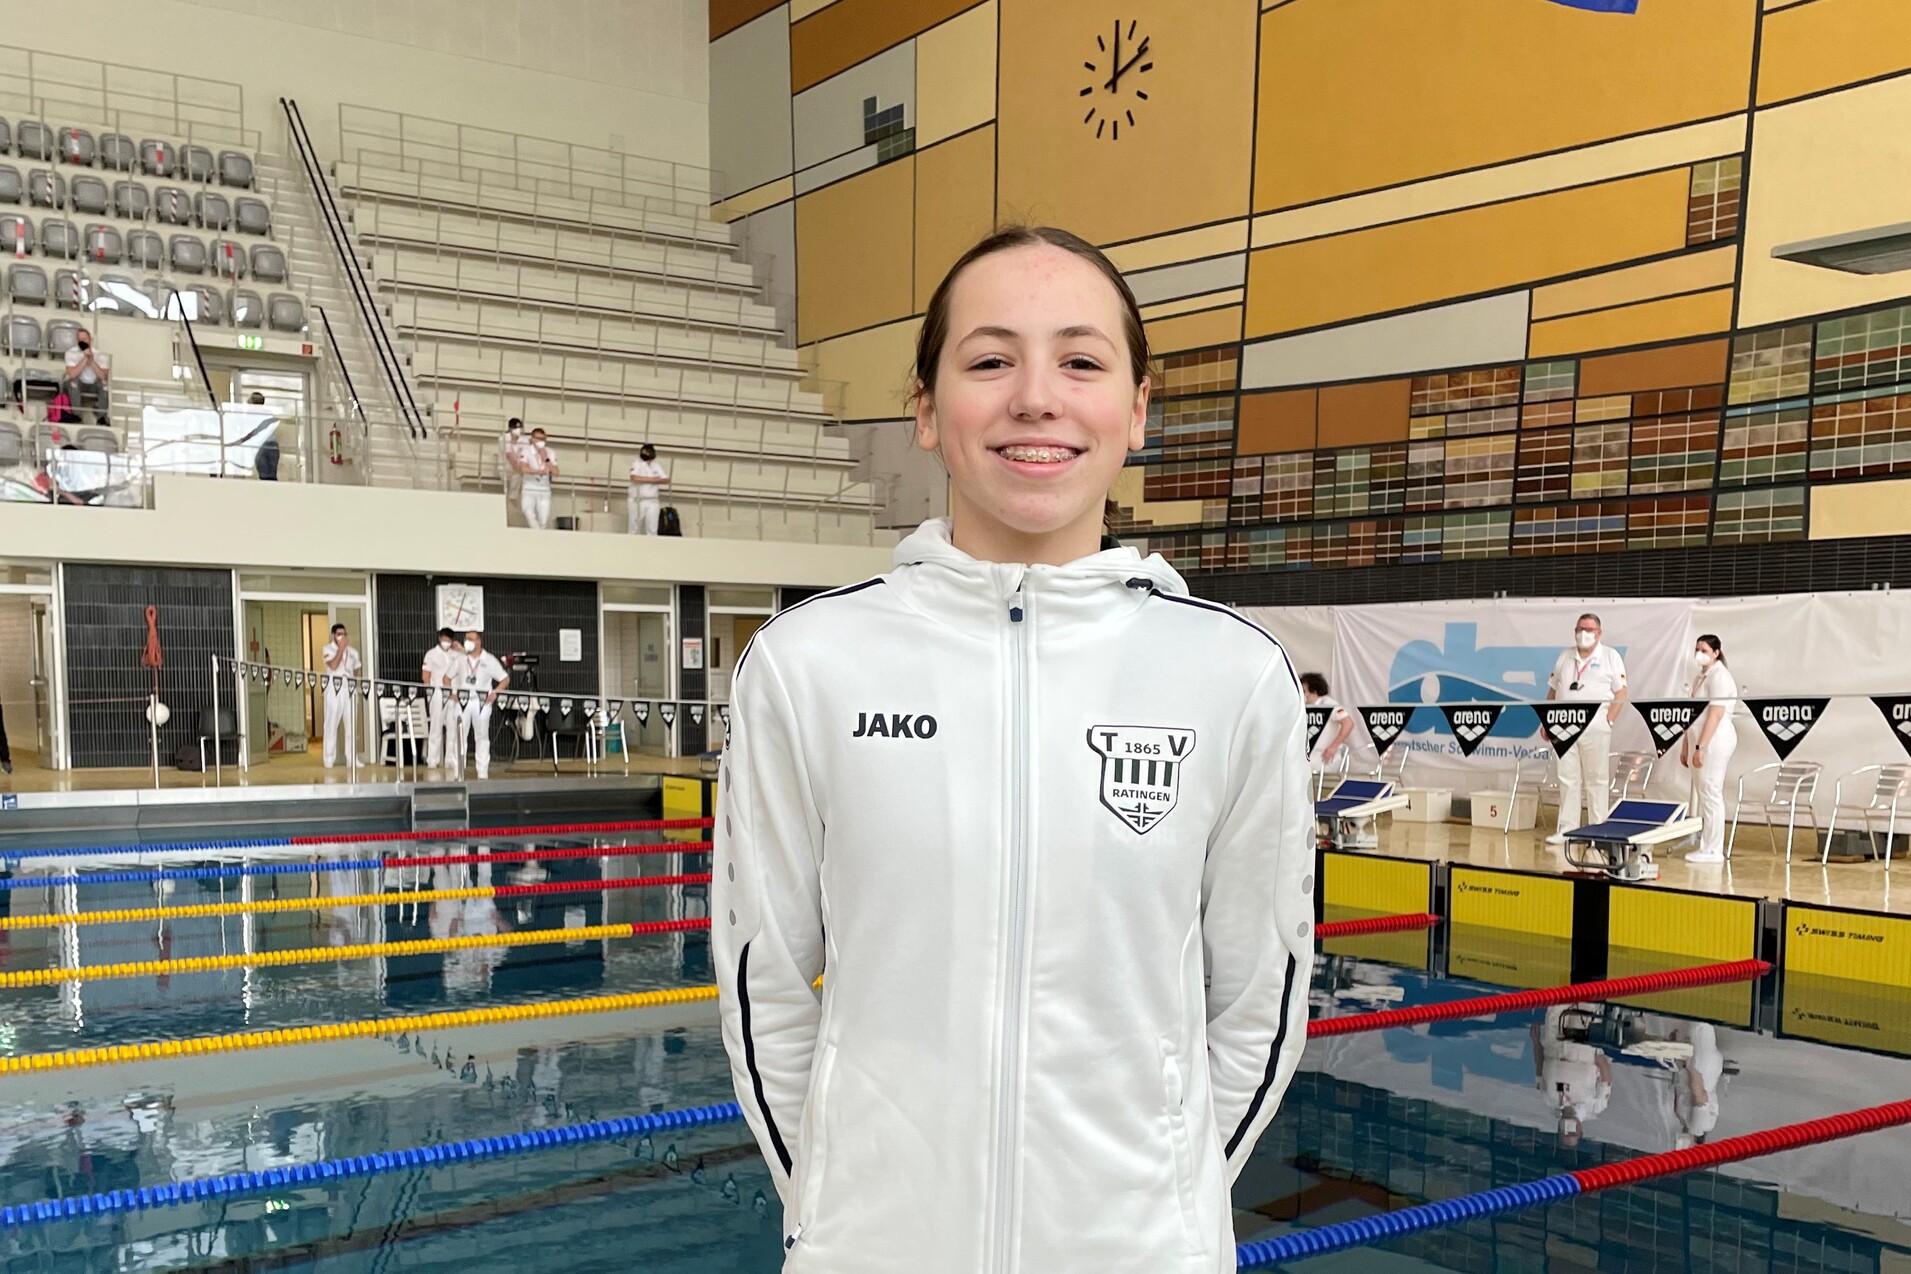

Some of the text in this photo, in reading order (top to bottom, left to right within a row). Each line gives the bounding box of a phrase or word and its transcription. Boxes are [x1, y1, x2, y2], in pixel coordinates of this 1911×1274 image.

[1370, 711, 1403, 725] arena
[1453, 710, 1491, 724] arena
[1547, 709, 1586, 723] arena
[1650, 707, 1691, 723] arena
[1762, 705, 1812, 721] arena
[852, 712, 938, 740] JAKO
[1100, 732, 1188, 756] T 1865 V
[1112, 788, 1171, 802] RATINGEN
[1490, 805, 1497, 817] 5
